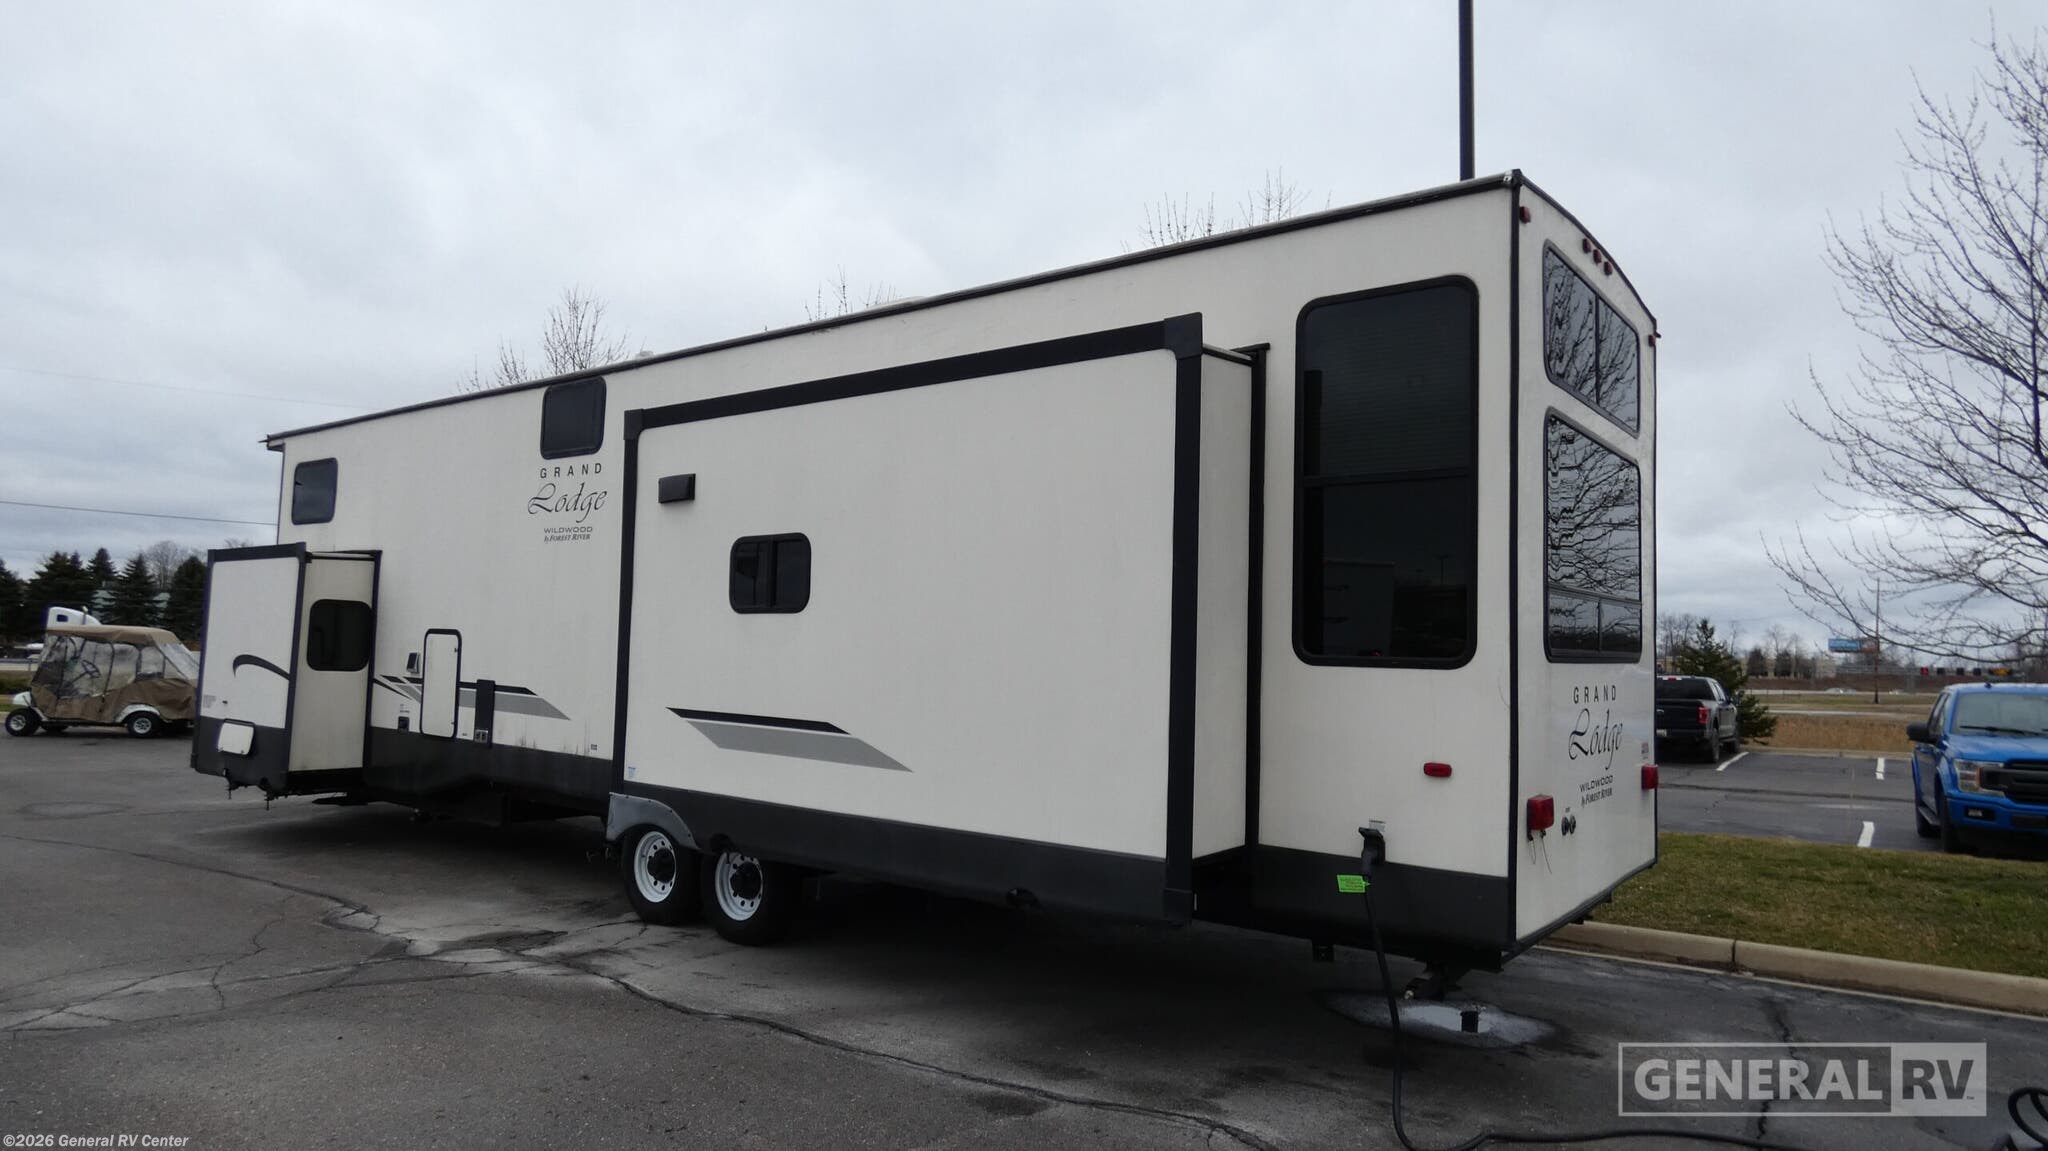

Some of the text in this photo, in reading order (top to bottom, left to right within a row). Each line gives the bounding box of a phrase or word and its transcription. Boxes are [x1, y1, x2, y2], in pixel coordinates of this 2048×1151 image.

[540, 463, 602, 479] GRAND
[528, 482, 607, 524] Lodge
[544, 526, 593, 534] WILDWOOD
[1573, 684, 1617, 704] GRAND
[1568, 708, 1623, 771] Lodge
[1579, 775, 1613, 792] WILDWOOD
